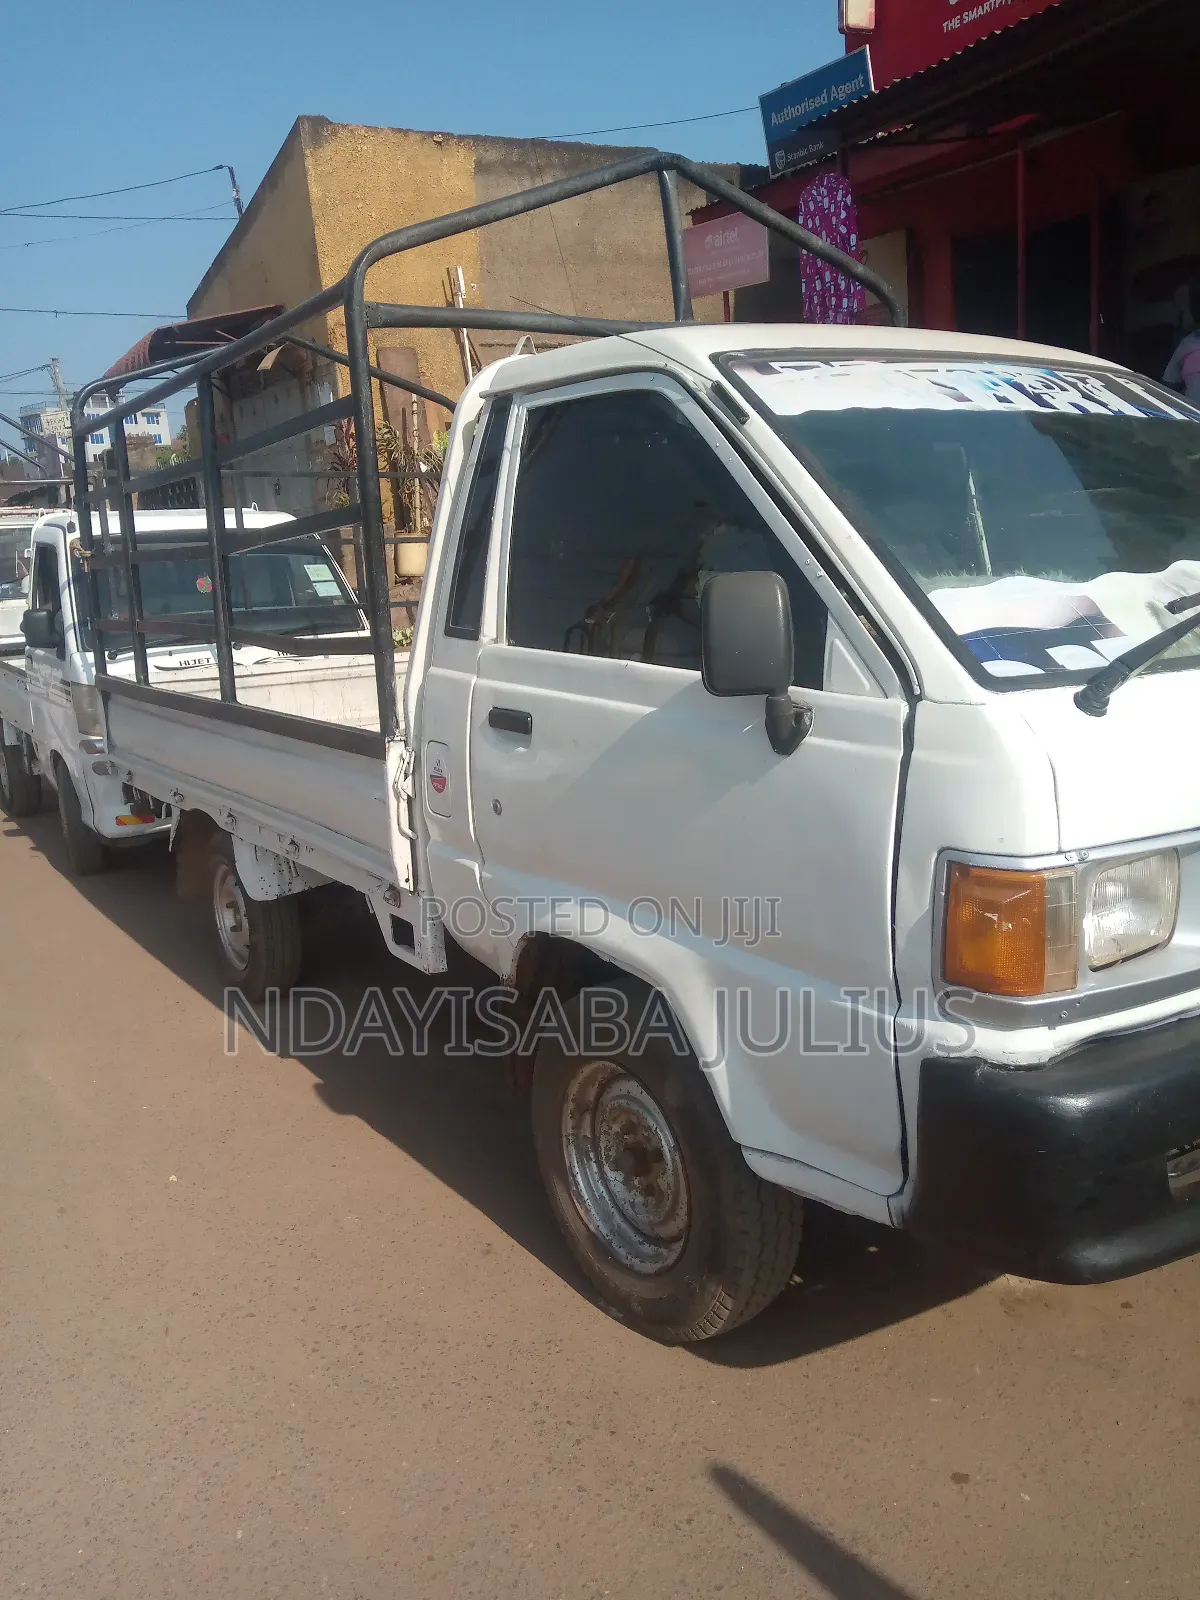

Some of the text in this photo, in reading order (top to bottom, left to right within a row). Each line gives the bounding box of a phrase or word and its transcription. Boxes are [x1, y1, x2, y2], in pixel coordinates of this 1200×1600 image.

[942, 0, 1014, 33] THE SMARTP
[771, 73, 865, 127] Authorised Agent
[786, 141, 824, 162] Stanbic Bank
[714, 226, 738, 247] airtel
[179, 657, 212, 667] HIJET
